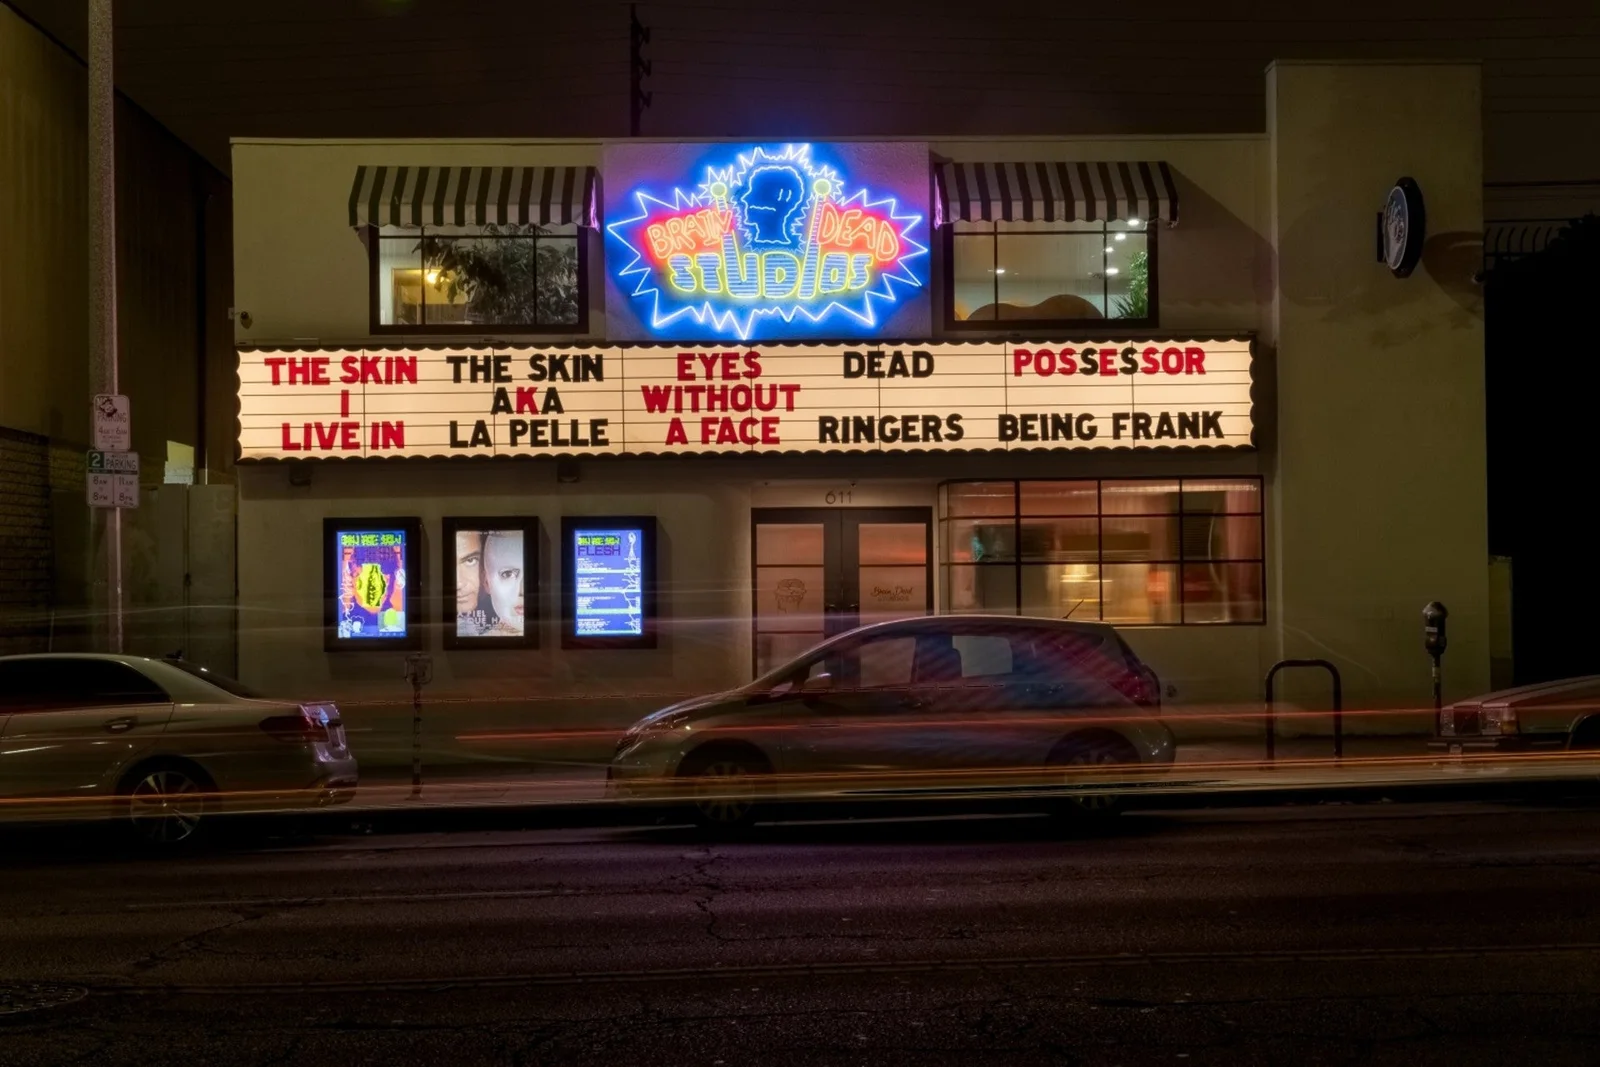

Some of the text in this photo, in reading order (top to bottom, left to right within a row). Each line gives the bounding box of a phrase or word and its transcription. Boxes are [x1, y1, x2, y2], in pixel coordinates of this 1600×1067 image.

[647, 202, 899, 262] BRAIN DEAD
[667, 226, 874, 299] STUDIOS
[265, 356, 418, 386] THE SKIN
[447, 354, 604, 384] THE SKIN
[677, 352, 763, 382] EYES
[843, 351, 935, 379] DEAD
[1014, 347, 1206, 377] POSSESSOR
[341, 390, 350, 418] I
[491, 387, 564, 416] AKA
[641, 384, 801, 414] WITHOUT
[282, 421, 405, 451] LIVE IN
[450, 419, 609, 449] LA PELLE
[665, 417, 781, 446] A FACE
[818, 415, 965, 444] RINGERS
[998, 412, 1225, 442] BEING FRANK
[91, 452, 137, 470] 2 PARKING
[825, 490, 852, 505] 611
[577, 546, 621, 556] FLESH
